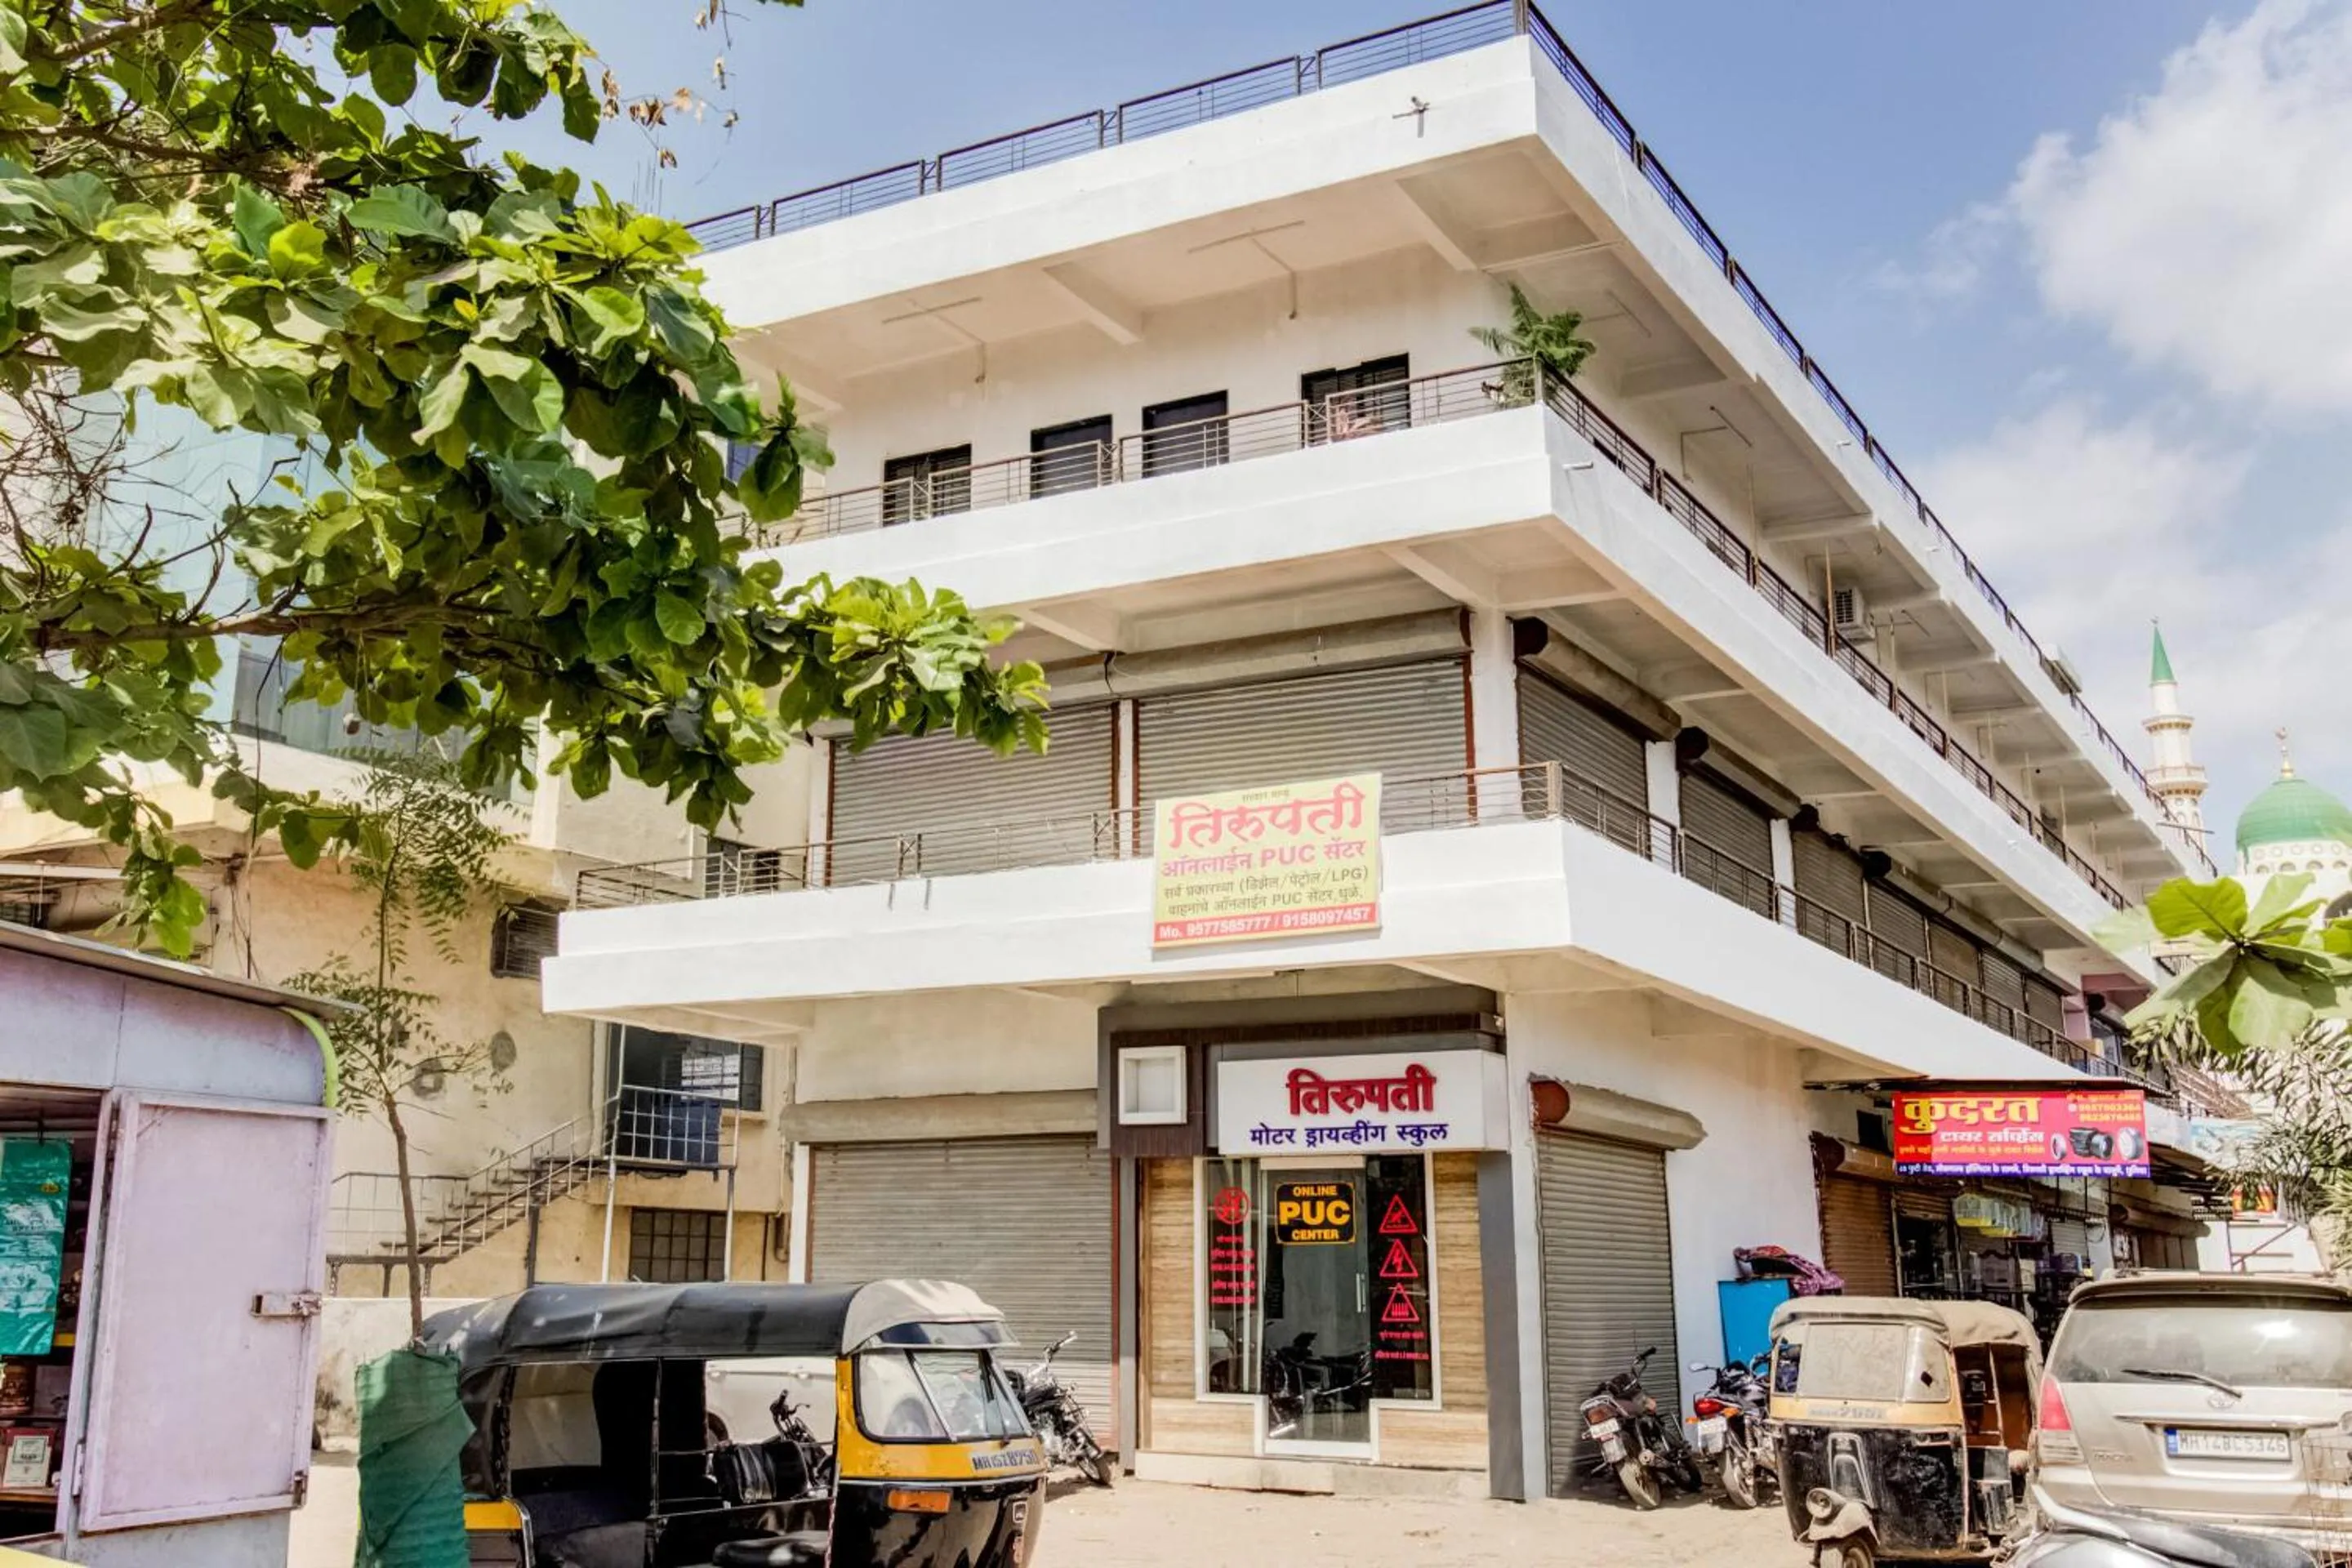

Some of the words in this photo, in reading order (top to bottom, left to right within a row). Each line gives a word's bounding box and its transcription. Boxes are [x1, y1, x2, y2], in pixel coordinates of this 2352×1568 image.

[1168, 780, 1366, 849] तिरुपती
[1161, 846, 1254, 878] ऑनलाईन
[1260, 844, 1316, 868] PUC
[1272, 891, 1303, 906] PUC
[1159, 925, 1183, 938] Mo.
[1285, 1063, 1437, 1116] तिरुपती
[1899, 1096, 2041, 1134] कुदरत
[1250, 1122, 1296, 1145] मोटर
[1396, 1123, 1449, 1146] स्कुल
[1293, 1185, 1338, 1196] ONLINE
[1278, 1200, 1351, 1226] PUC
[1291, 1229, 1339, 1241] CENTER
